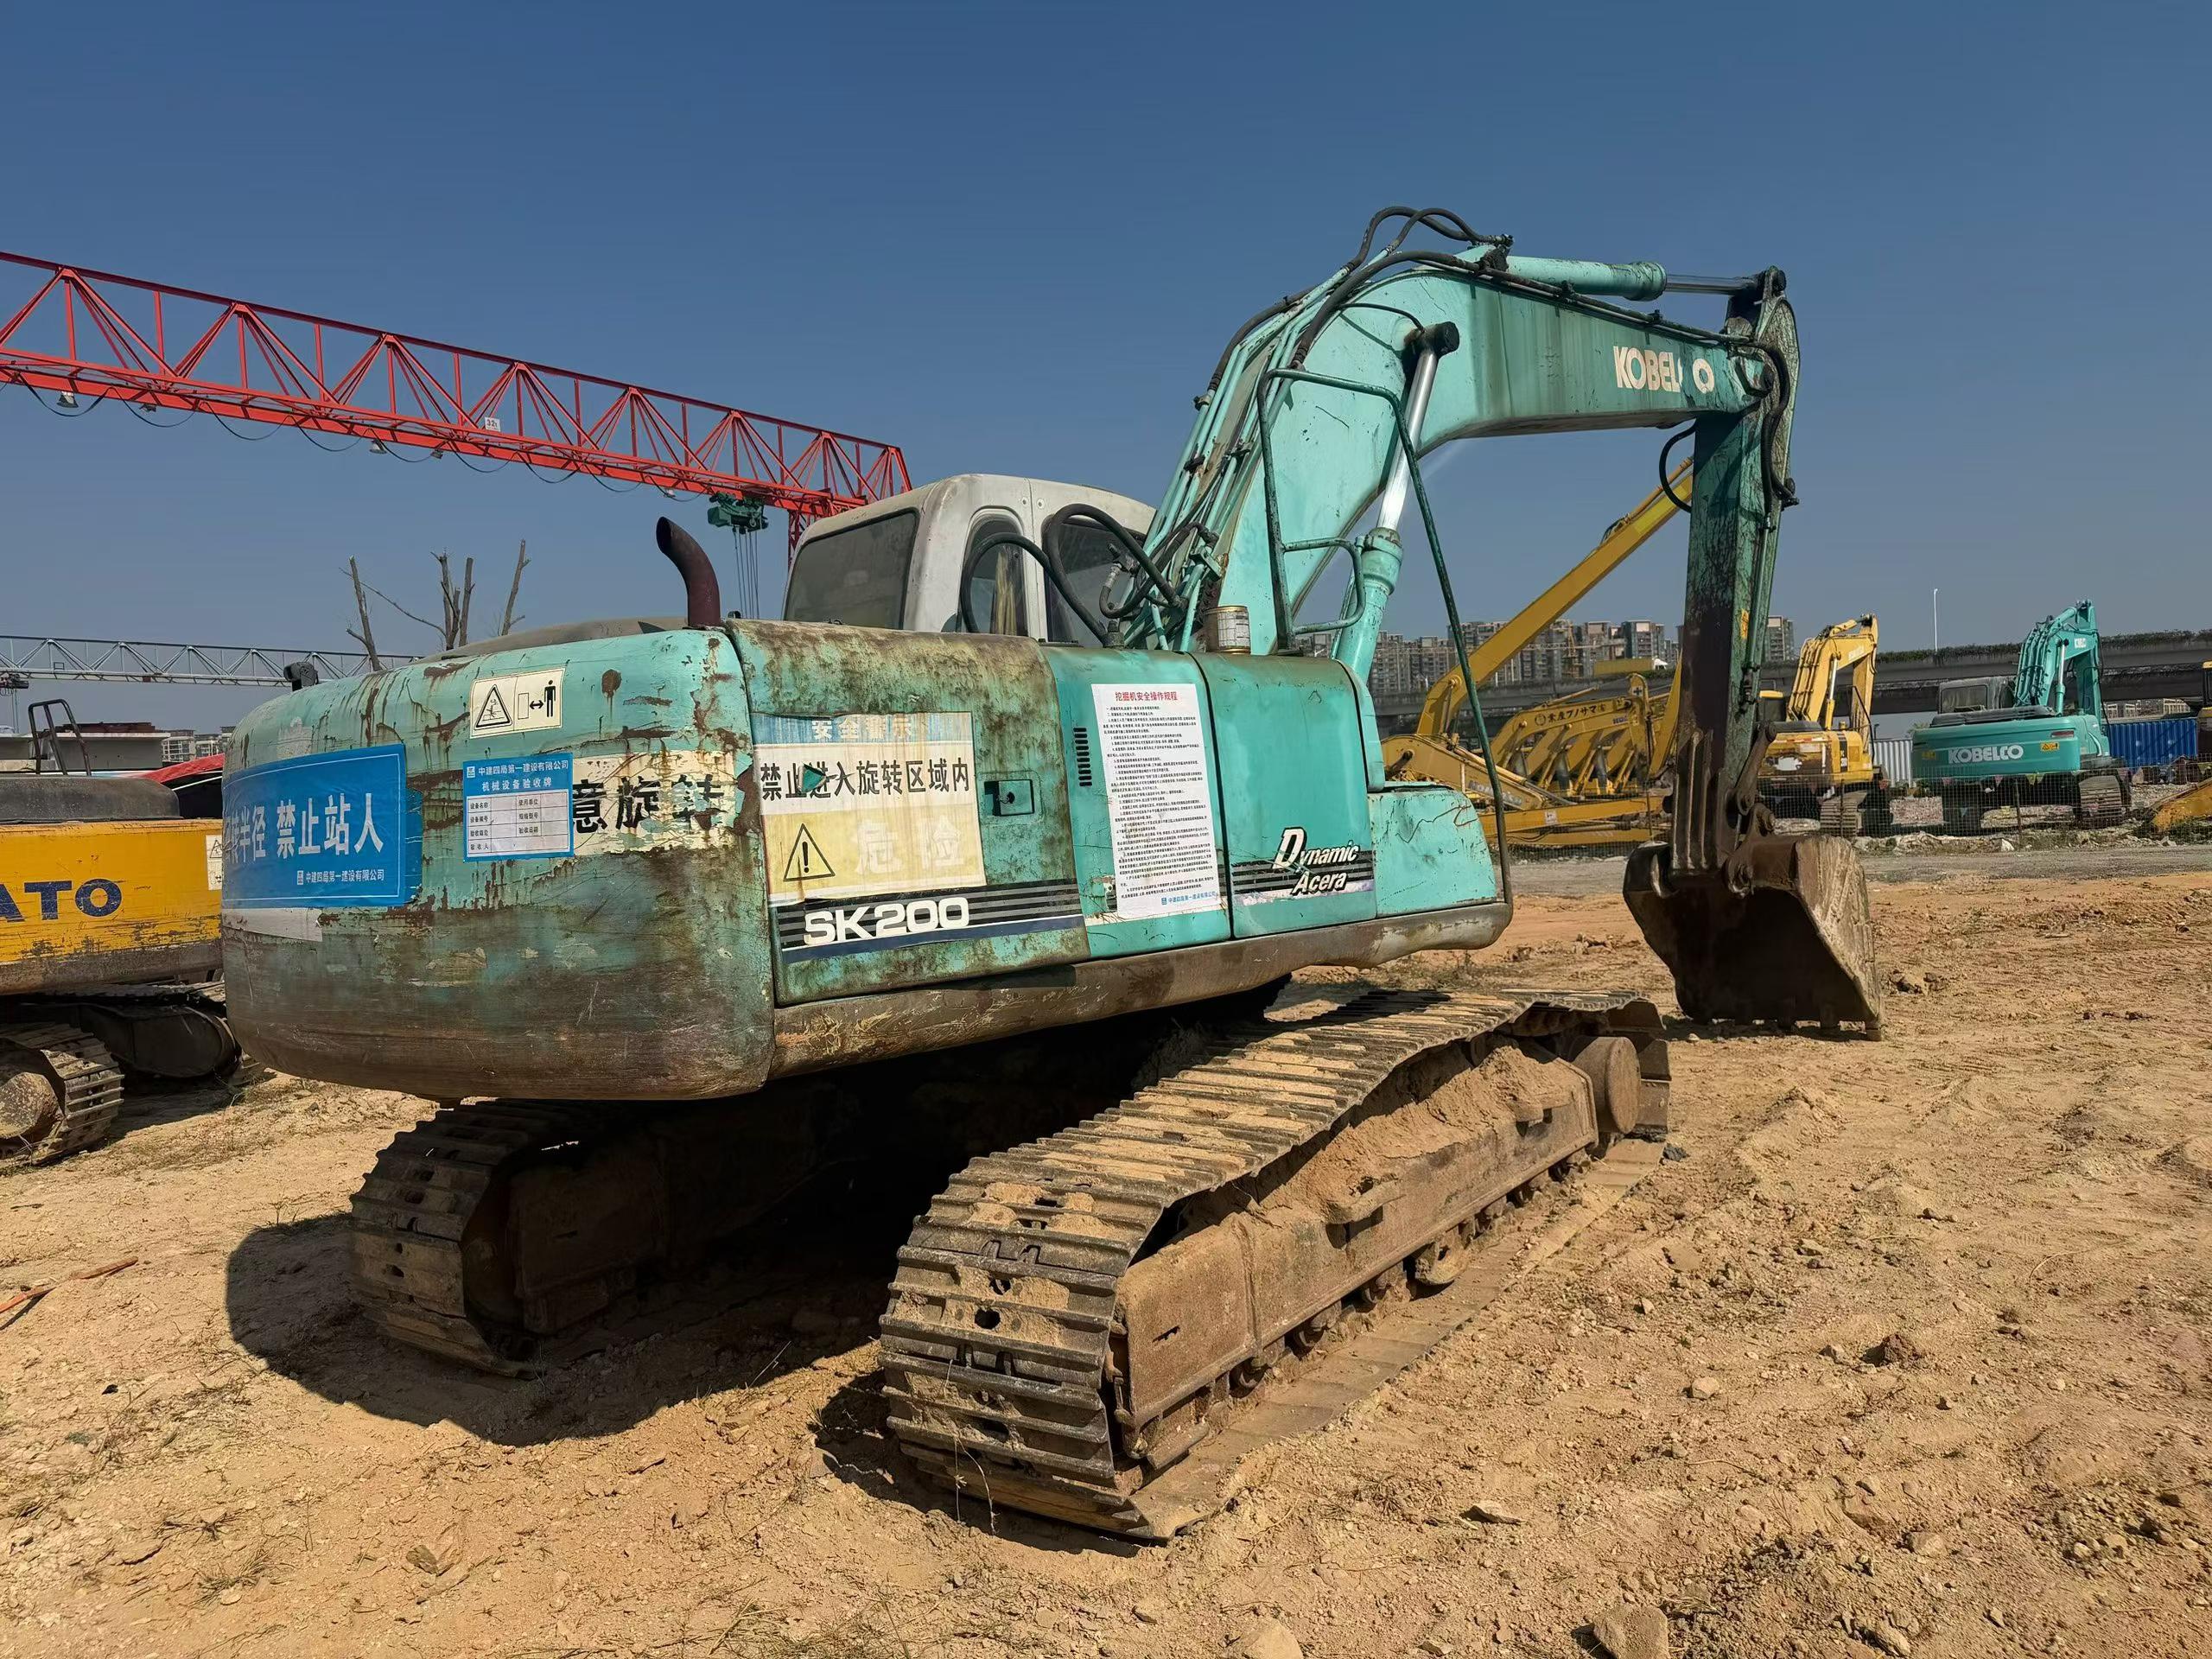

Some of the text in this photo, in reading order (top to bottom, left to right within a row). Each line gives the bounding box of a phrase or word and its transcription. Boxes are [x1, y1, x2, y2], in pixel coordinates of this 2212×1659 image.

[1613, 346, 1715, 395] KOBELO
[1115, 690, 1179, 702] 挖掘机安全操作规程
[1948, 744, 2024, 764] KOBELCO
[478, 760, 569, 776] 中建四局第一建设有限公司
[481, 777, 553, 792] 机械设备验收牌
[276, 792, 385, 860] 禁止站人
[852, 814, 964, 874] 危险
[1272, 826, 1361, 873] Dynamic
[305, 868, 385, 883] 中建四局第一建设有限公司
[1290, 871, 1348, 895] Acera
[804, 896, 969, 946] SK200
